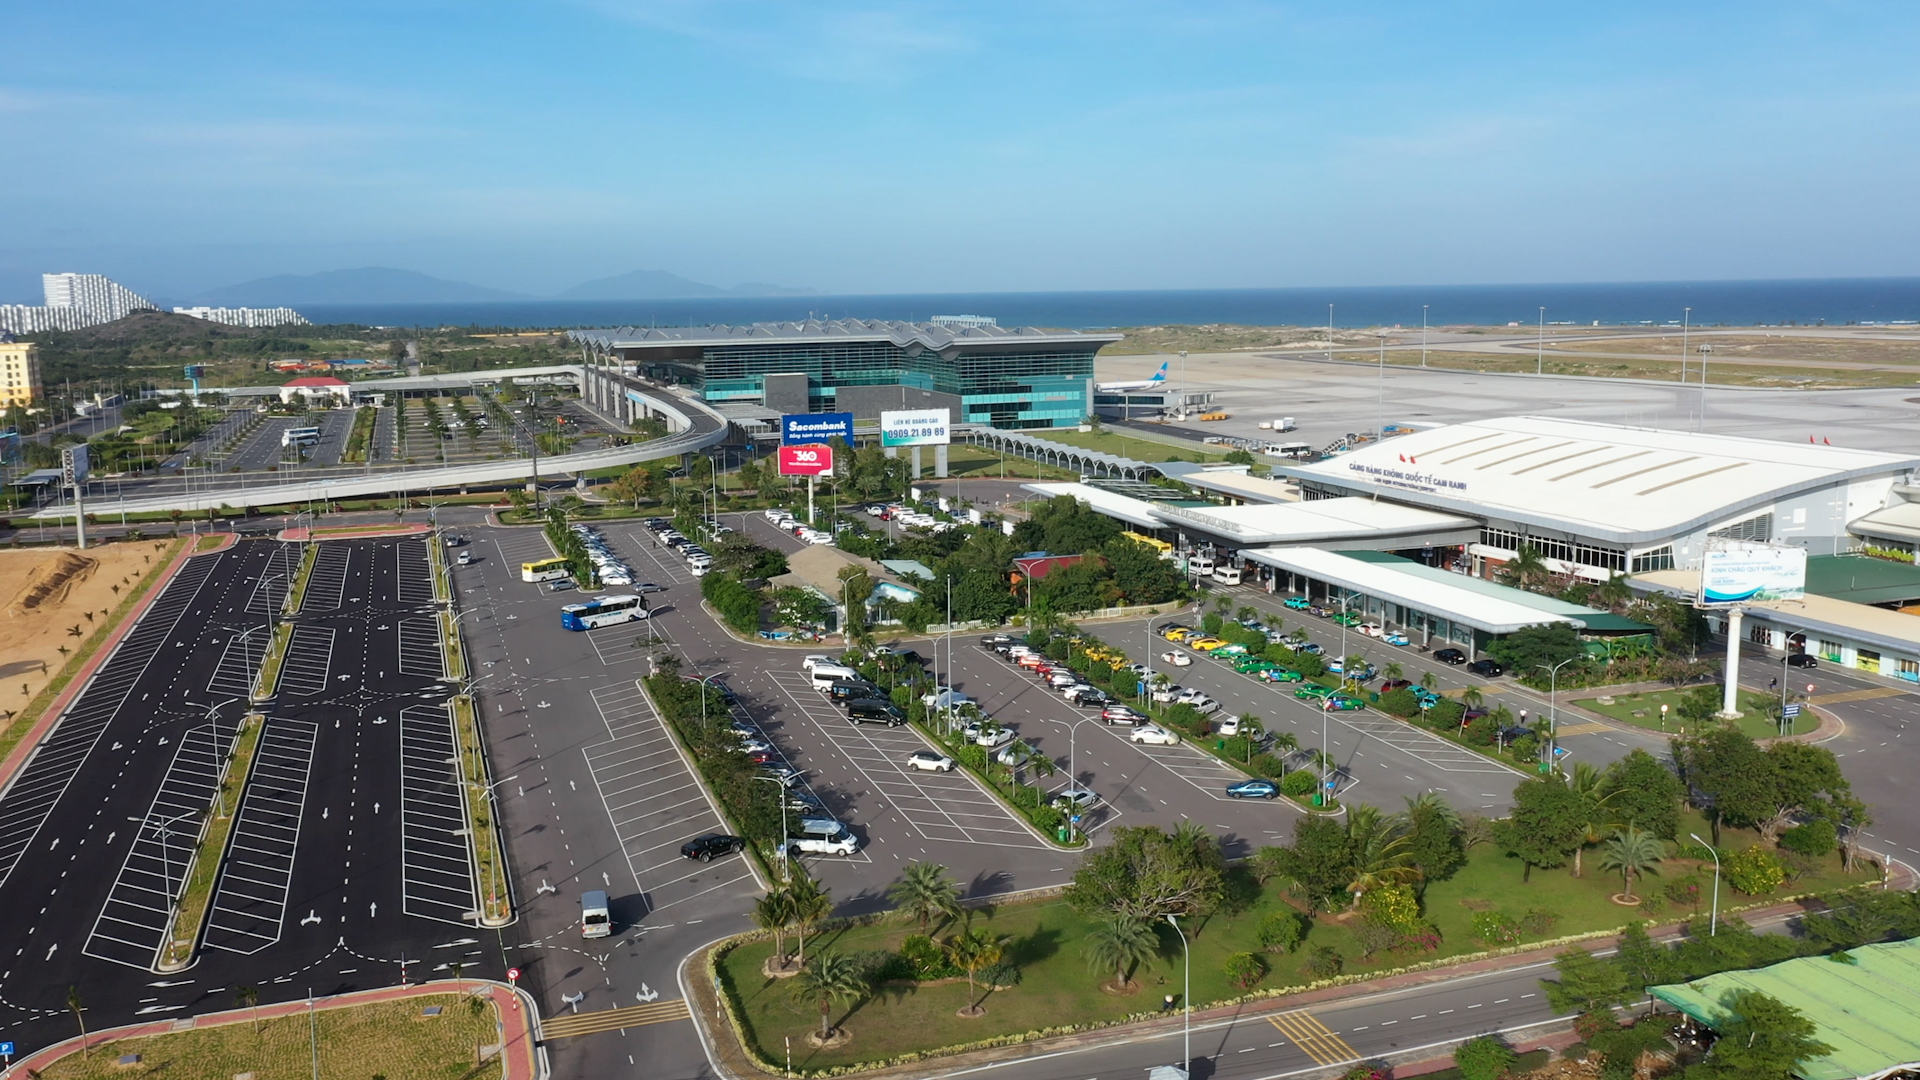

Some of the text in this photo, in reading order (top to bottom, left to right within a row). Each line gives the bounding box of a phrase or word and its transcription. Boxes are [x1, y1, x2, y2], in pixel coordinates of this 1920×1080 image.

[789, 421, 846, 432] Sacombank
[888, 427, 944, 438] 0909 21 89 89
[1405, 471, 1423, 482] QUỐC
[1424, 474, 1432, 484] TẾ
